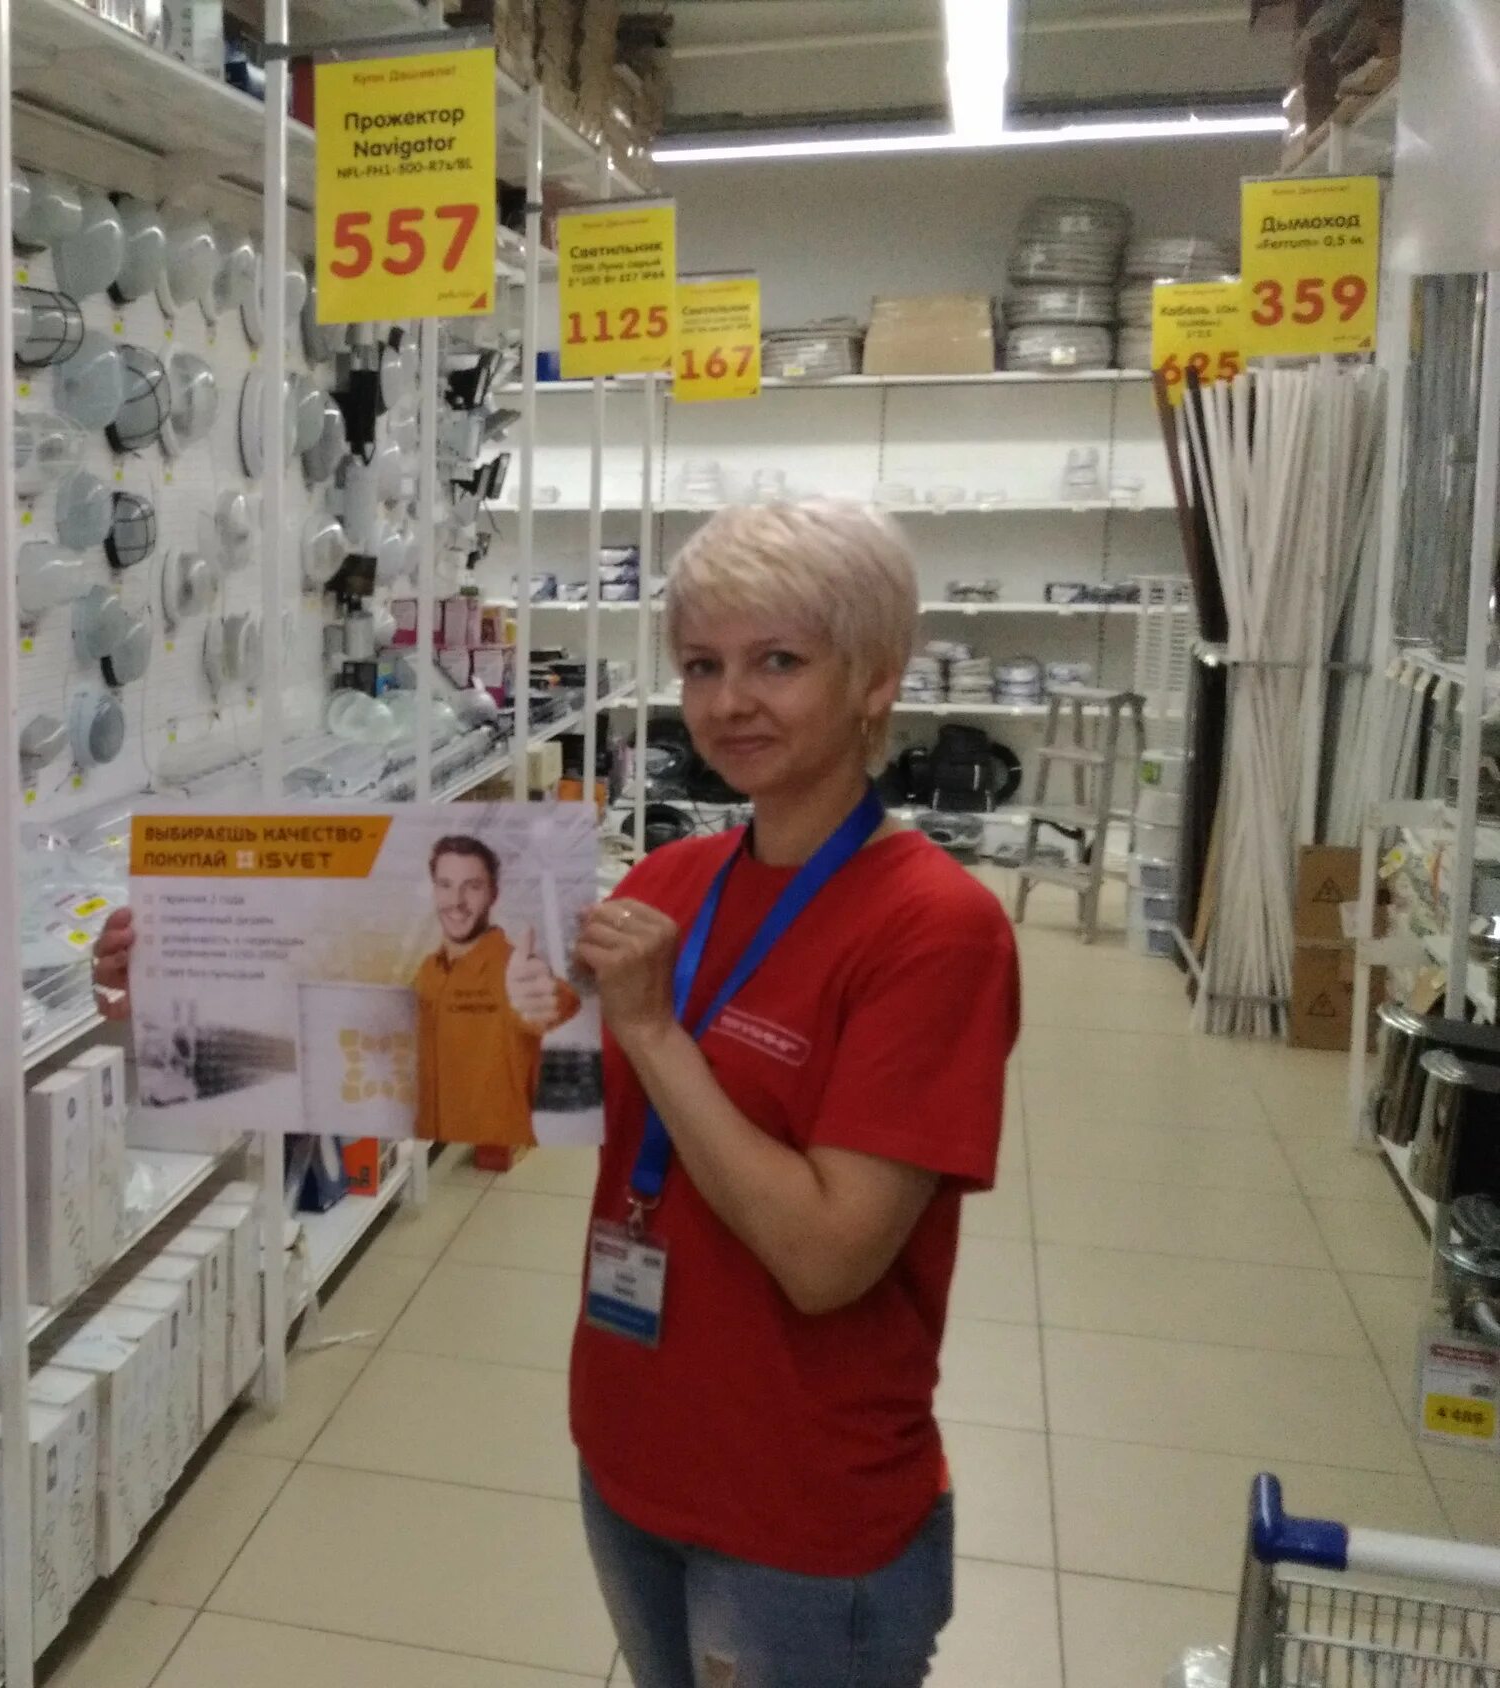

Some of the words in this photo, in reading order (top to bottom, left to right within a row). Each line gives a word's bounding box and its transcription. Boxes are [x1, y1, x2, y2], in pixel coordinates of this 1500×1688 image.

[344, 107, 466, 134] Прожектор
[353, 137, 457, 159] Navigator
[1260, 214, 1361, 234] Дымоход
[329, 203, 480, 279] 557
[569, 241, 663, 259] Светильник
[1251, 274, 1368, 327] 359
[566, 305, 668, 344] 1125
[680, 345, 755, 380] 167
[144, 826, 258, 842] ВЫБИРАЕШЬ
[263, 826, 364, 843] КАЧЕСТВО
[143, 851, 228, 868] ПОКУПАЙ
[258, 852, 333, 869] iSVET
